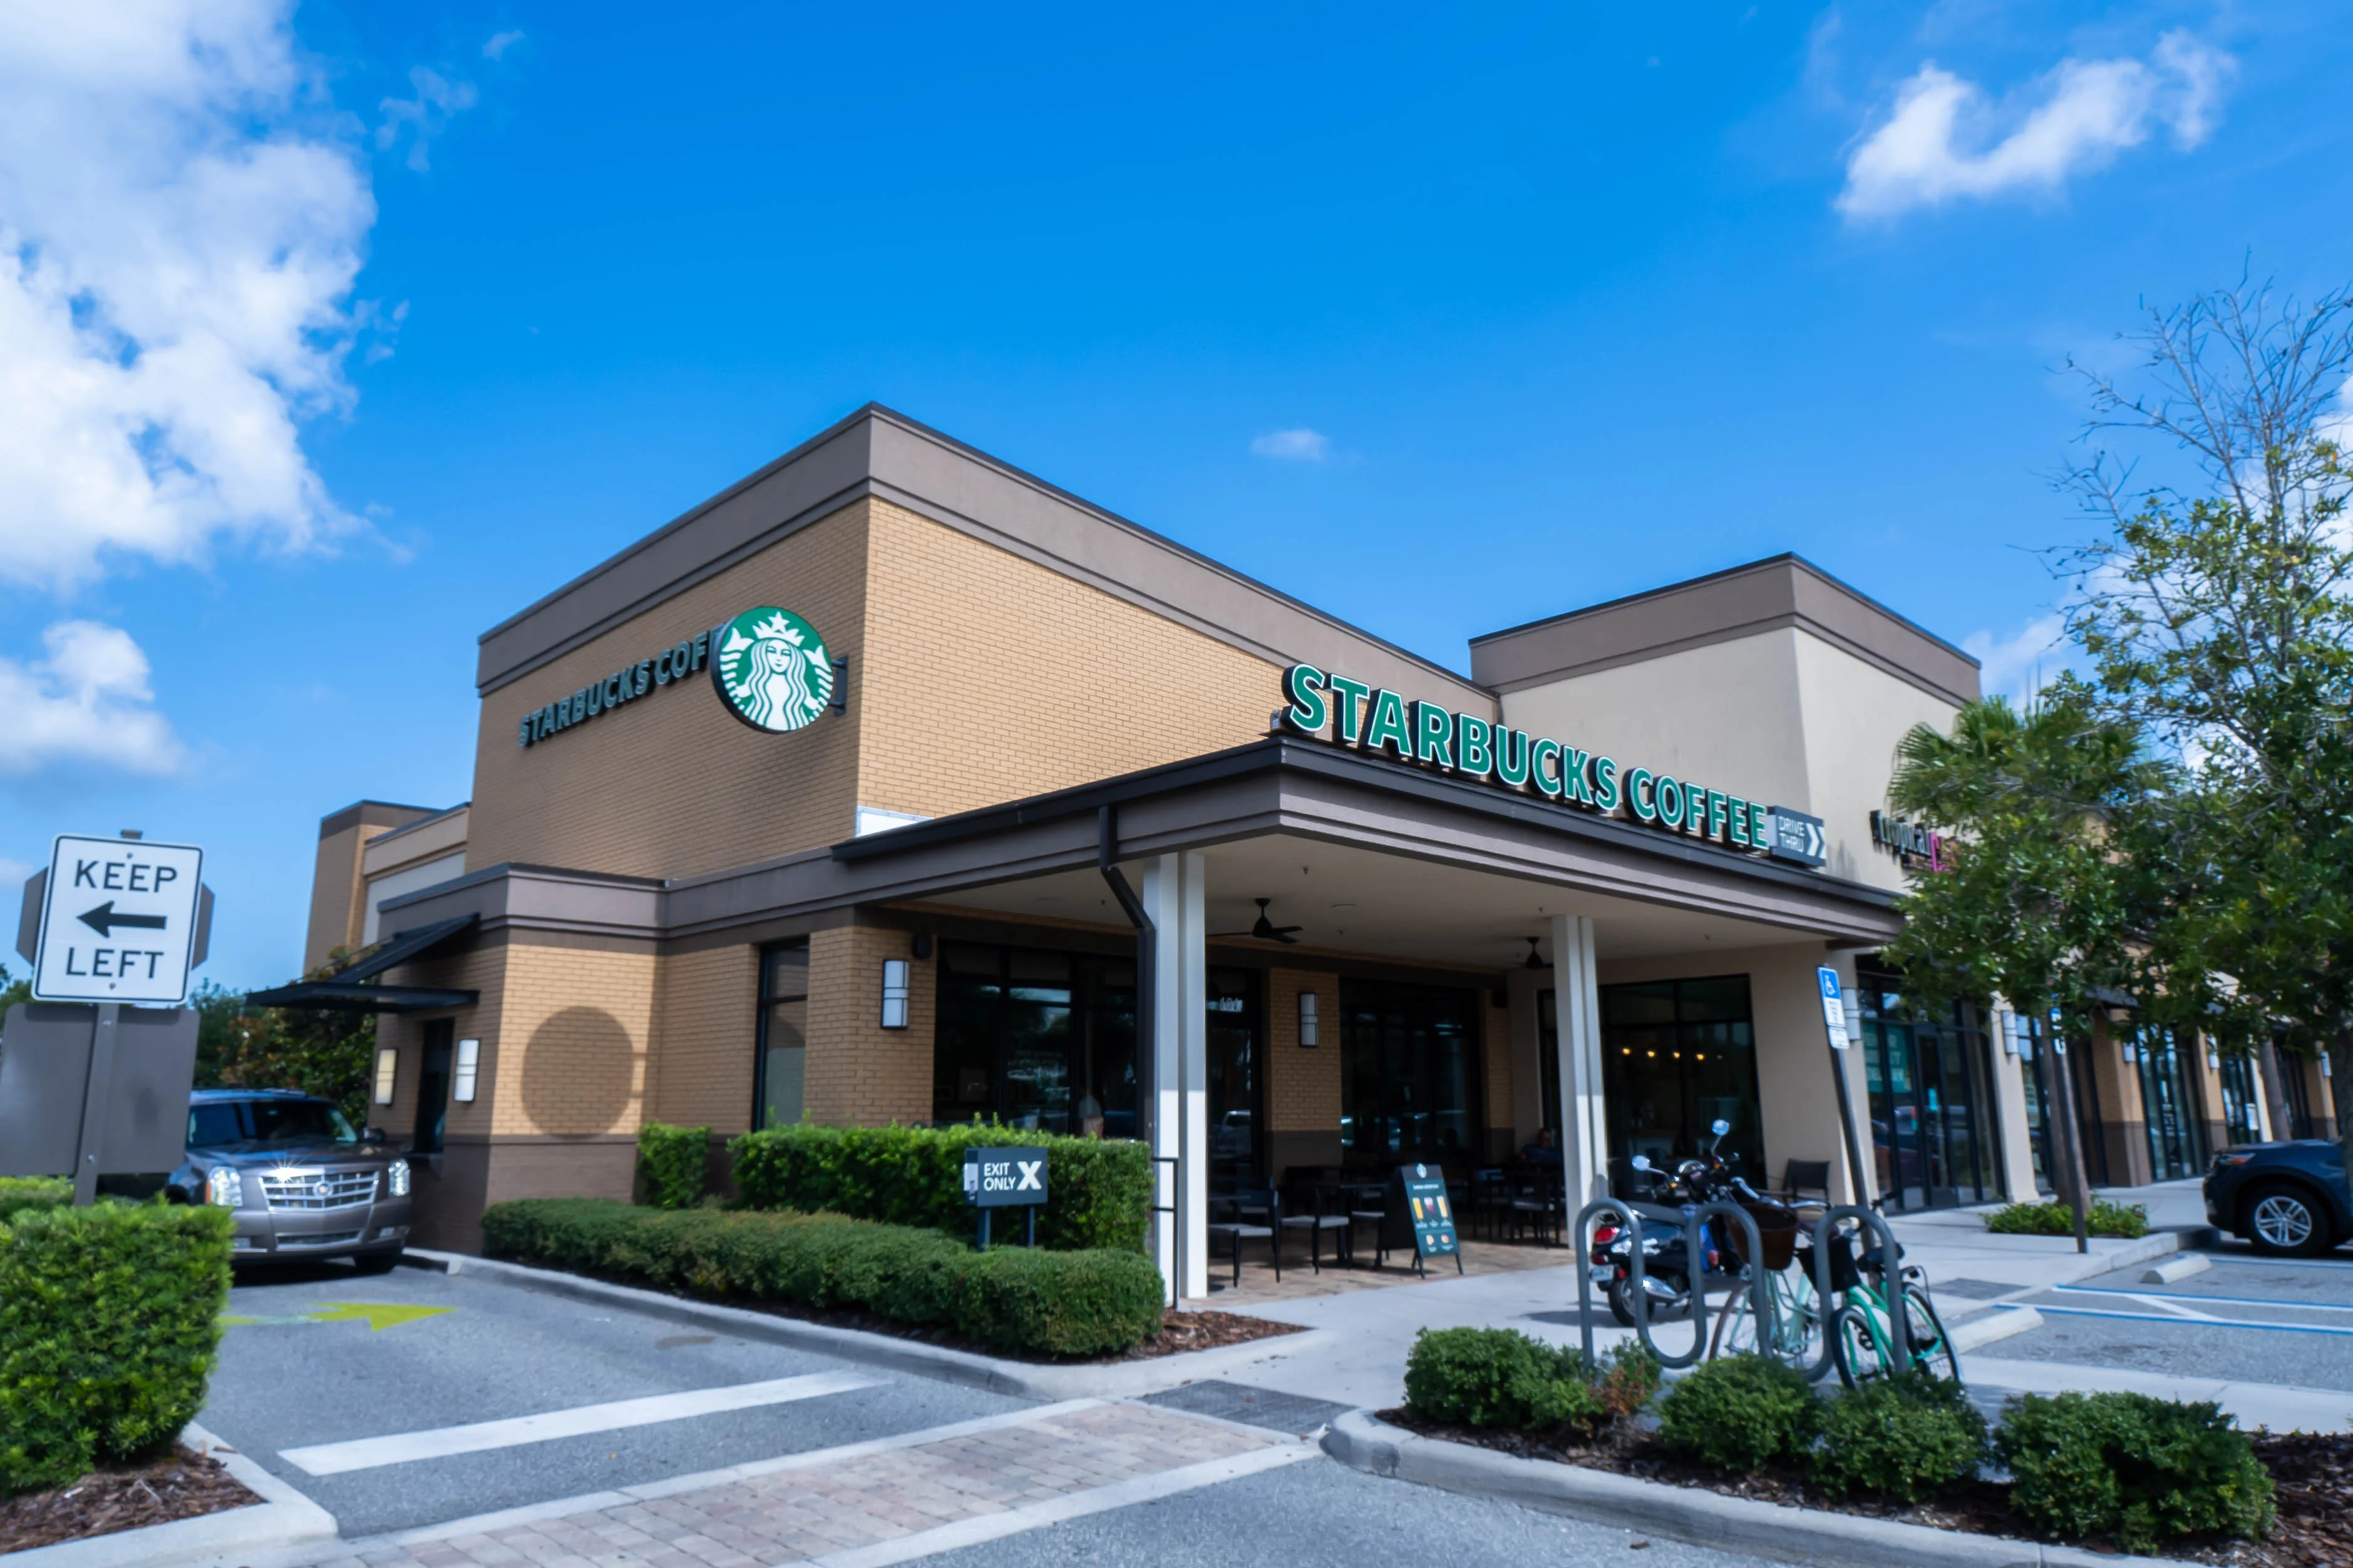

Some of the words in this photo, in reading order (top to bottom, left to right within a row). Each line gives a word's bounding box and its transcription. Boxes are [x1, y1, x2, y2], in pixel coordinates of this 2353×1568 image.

[518, 657, 651, 746] STARBUCKS
[1287, 662, 1619, 811] STARBUCKS
[1629, 767, 1769, 849] COFFEE
[1778, 815, 1805, 837] DRIVE
[1778, 833, 1805, 853] THRU
[74, 858, 178, 893] KEEP
[65, 946, 164, 979] LEFT
[984, 1162, 1010, 1177] EXIT
[984, 1177, 1016, 1192] ONLY
